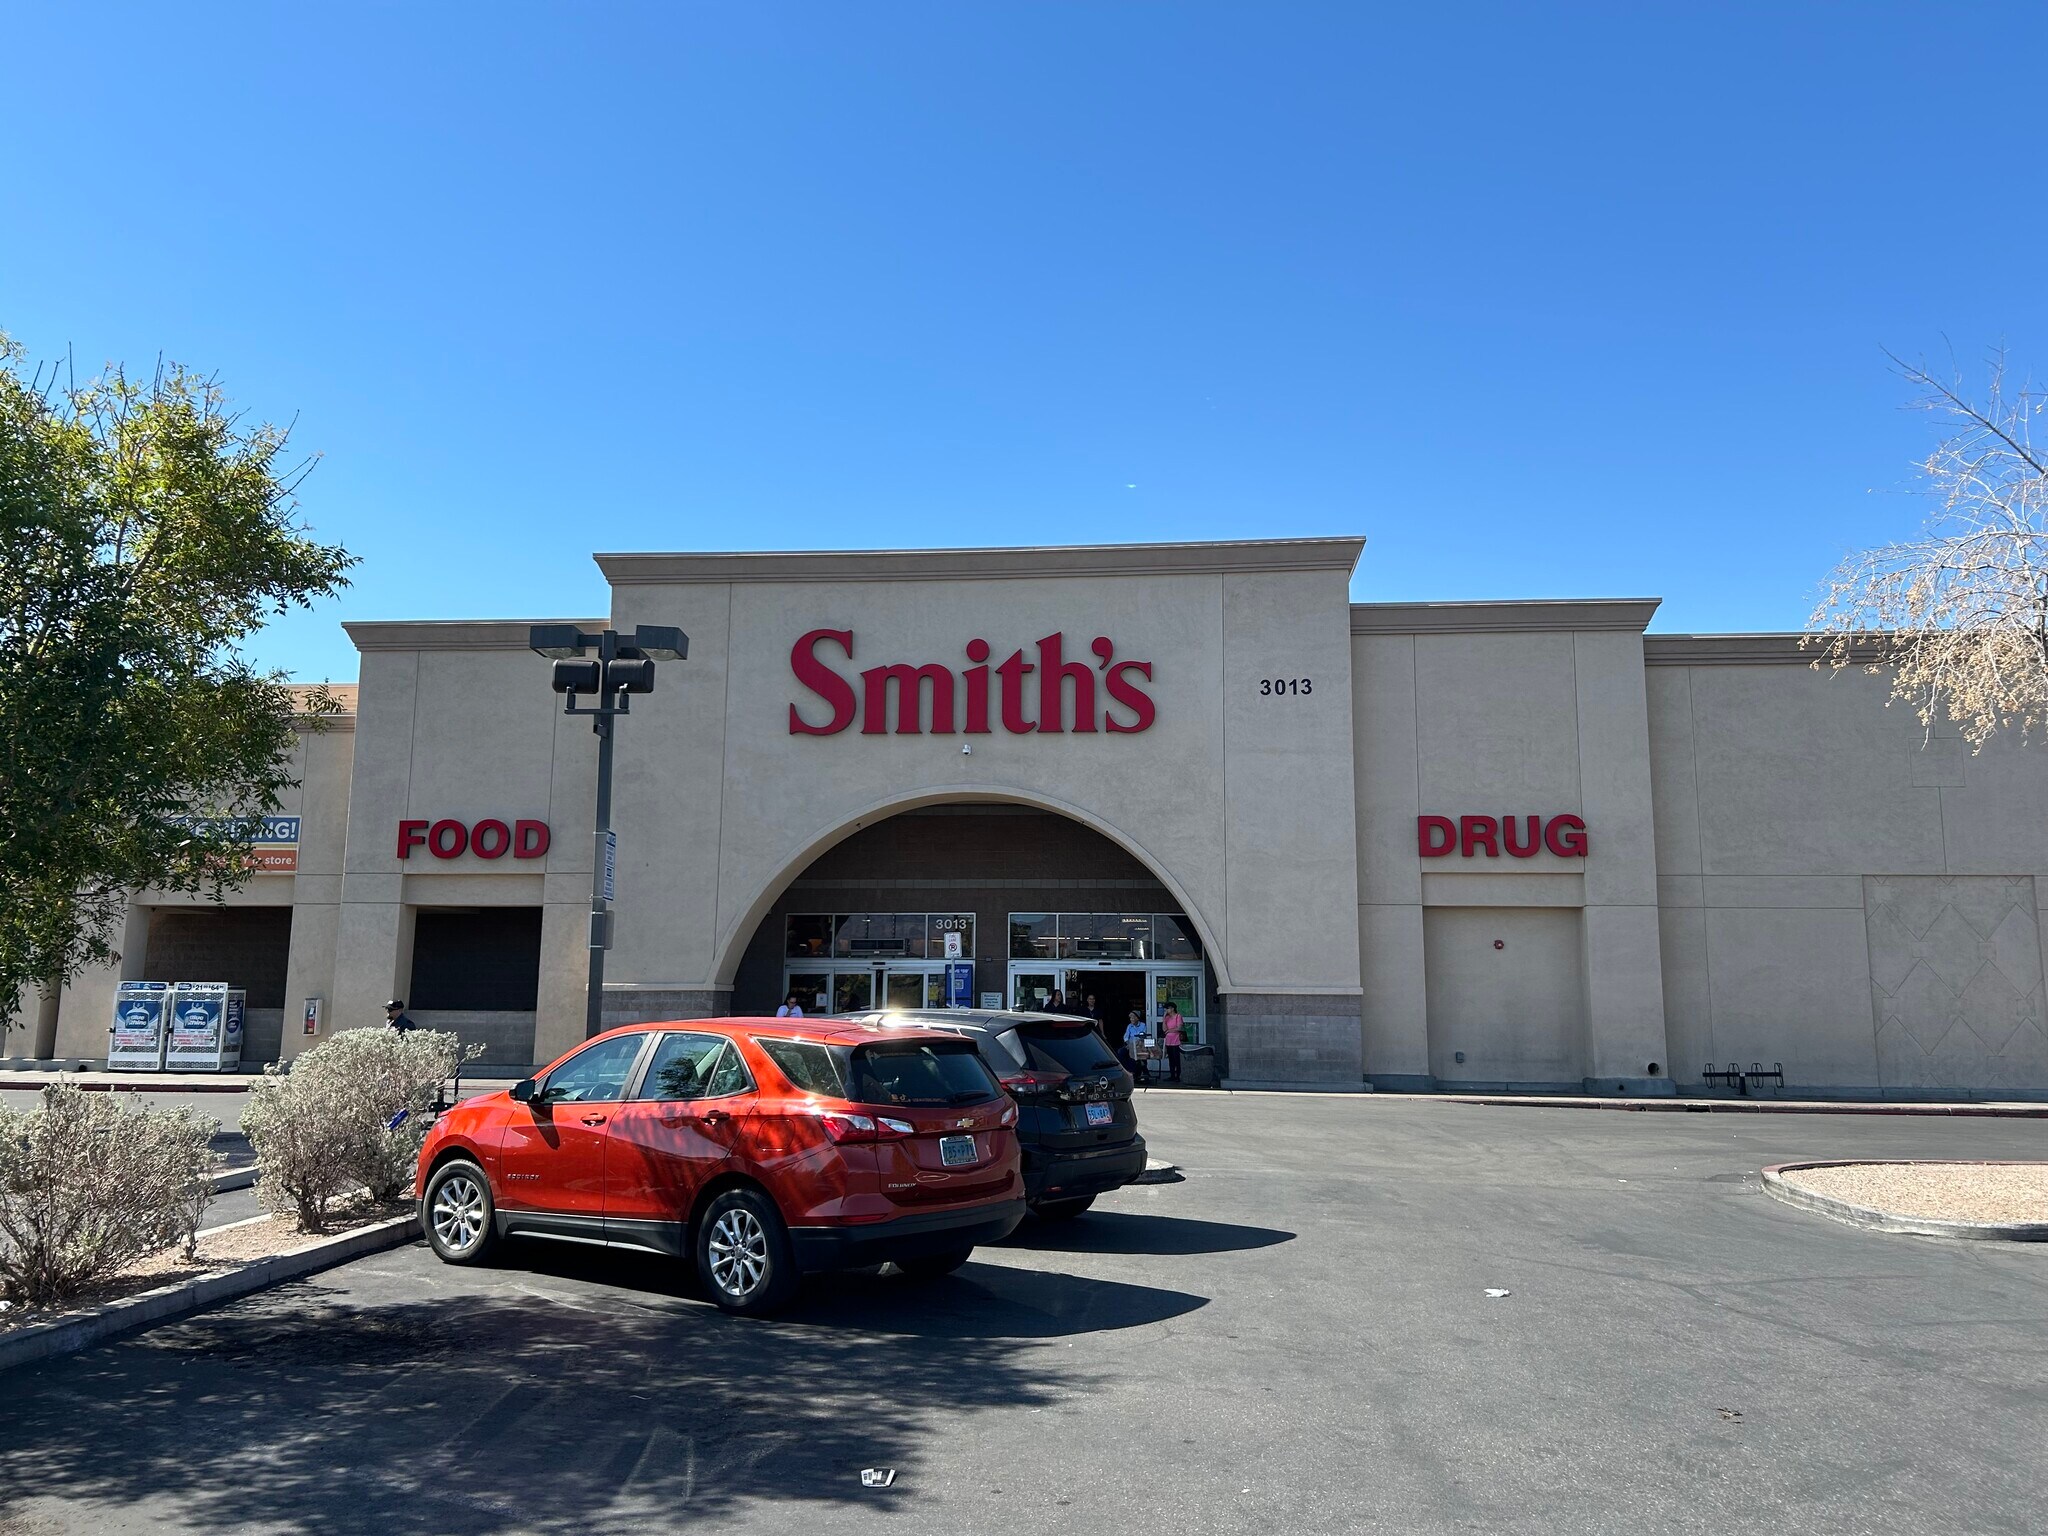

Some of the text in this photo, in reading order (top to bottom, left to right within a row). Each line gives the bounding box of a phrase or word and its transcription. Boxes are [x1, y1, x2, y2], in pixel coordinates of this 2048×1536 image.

[789, 628, 1156, 736] Smith's
[1259, 678, 1313, 696] 3013
[397, 818, 549, 860] FOOD
[1417, 814, 1588, 858] DRUG
[265, 856, 295, 865] store.
[935, 919, 967, 930] 3013
